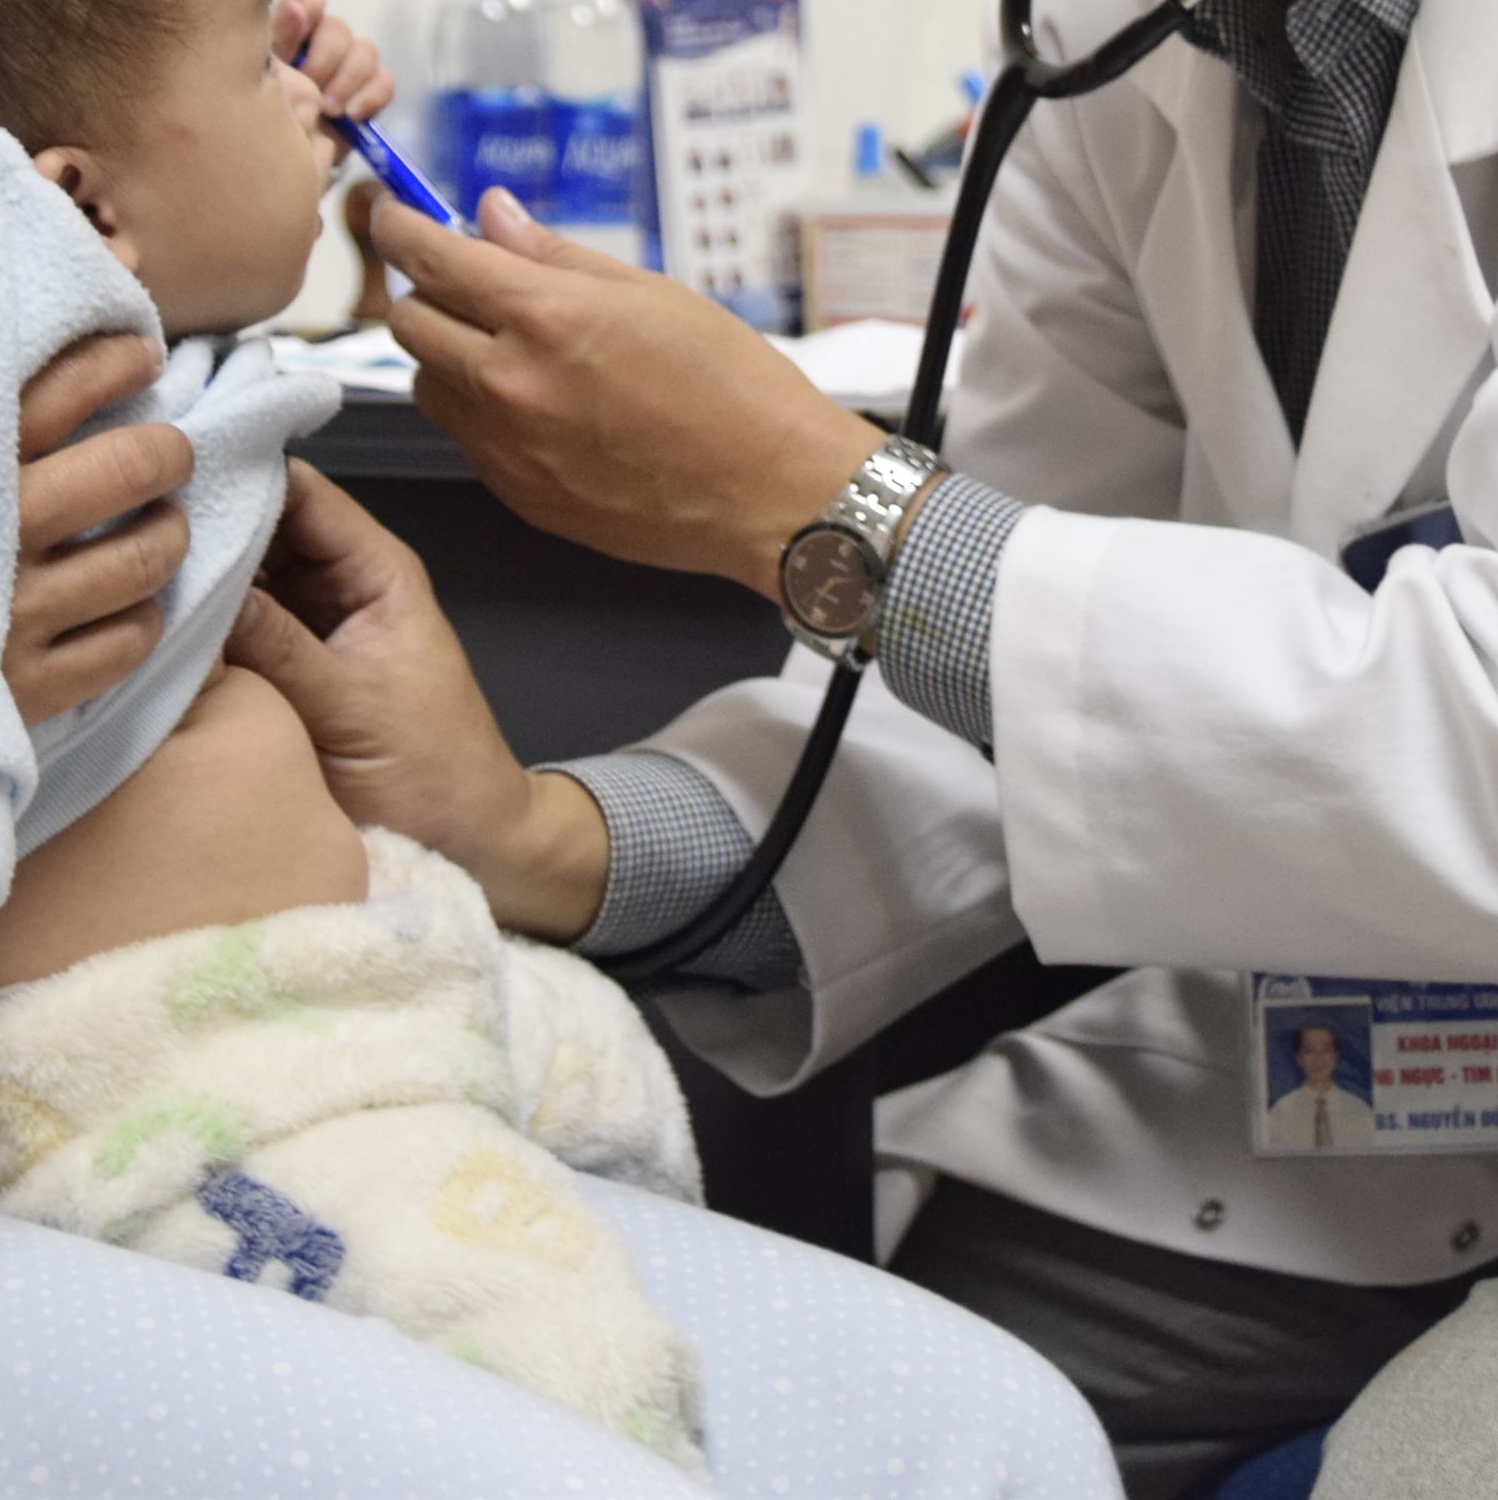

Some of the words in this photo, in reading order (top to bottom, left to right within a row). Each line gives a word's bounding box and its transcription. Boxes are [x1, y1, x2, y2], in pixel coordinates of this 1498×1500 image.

[1397, 1034, 1442, 1052] KHOA
[1447, 1033, 1498, 1054] NGOẠI
[1399, 1067, 1444, 1088] NGỰC
[1463, 1066, 1491, 1083] TIM
[1408, 1105, 1475, 1129] NGUYỄN
